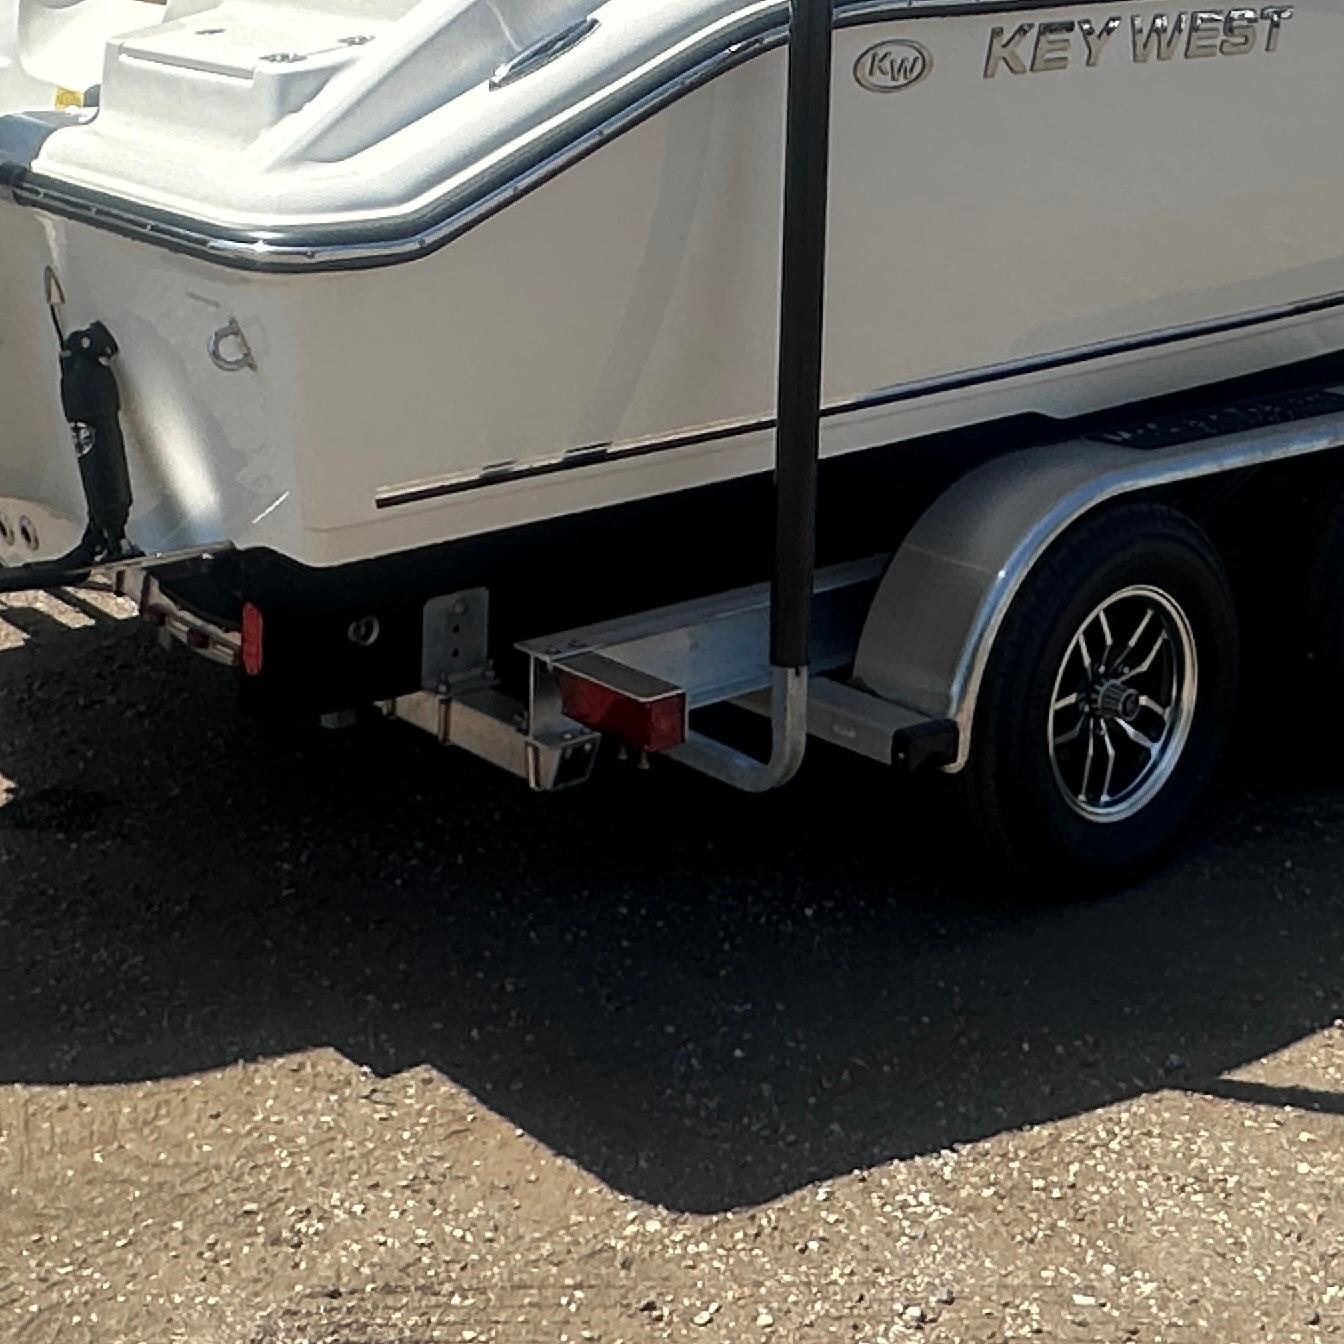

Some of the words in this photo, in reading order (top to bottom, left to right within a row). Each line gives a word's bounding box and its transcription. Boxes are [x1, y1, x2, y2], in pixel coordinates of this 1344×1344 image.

[868, 50, 920, 82] KW
[982, 16, 1122, 79] KEY
[1130, 5, 1295, 64] WEST
